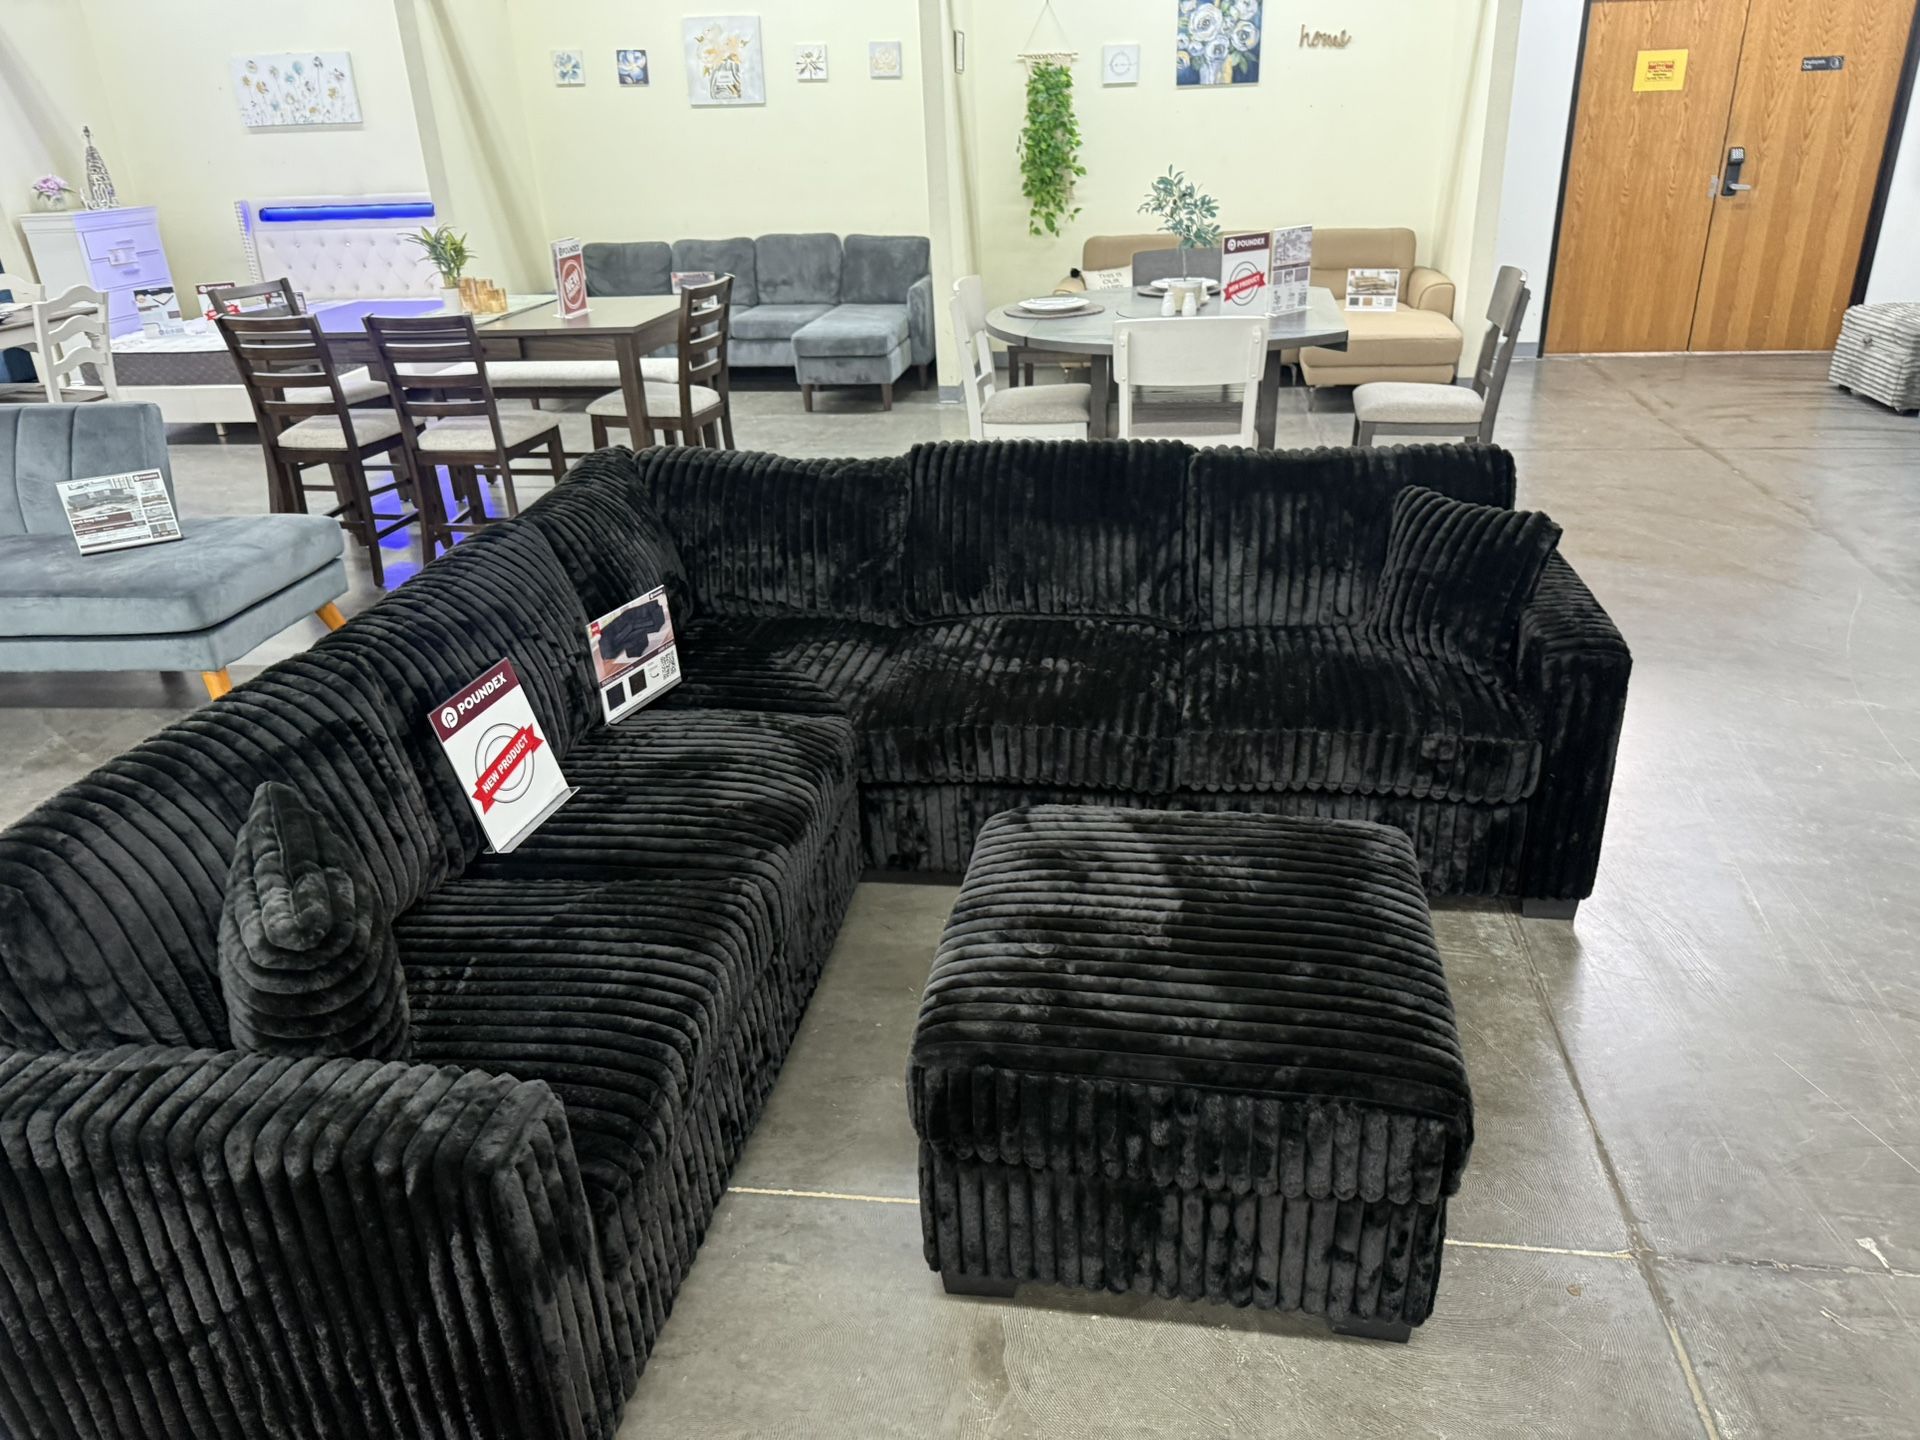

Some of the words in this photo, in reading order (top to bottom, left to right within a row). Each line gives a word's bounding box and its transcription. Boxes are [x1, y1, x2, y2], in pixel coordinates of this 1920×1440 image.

[1299, 24, 1352, 49] home
[1236, 237, 1266, 248] POUNDEX
[1228, 284, 1239, 292] NEW
[1239, 274, 1260, 287] PRODUCT
[457, 671, 507, 716] POUNDEX
[481, 773, 500, 794] NEW
[499, 733, 529, 774] PRODUCT
